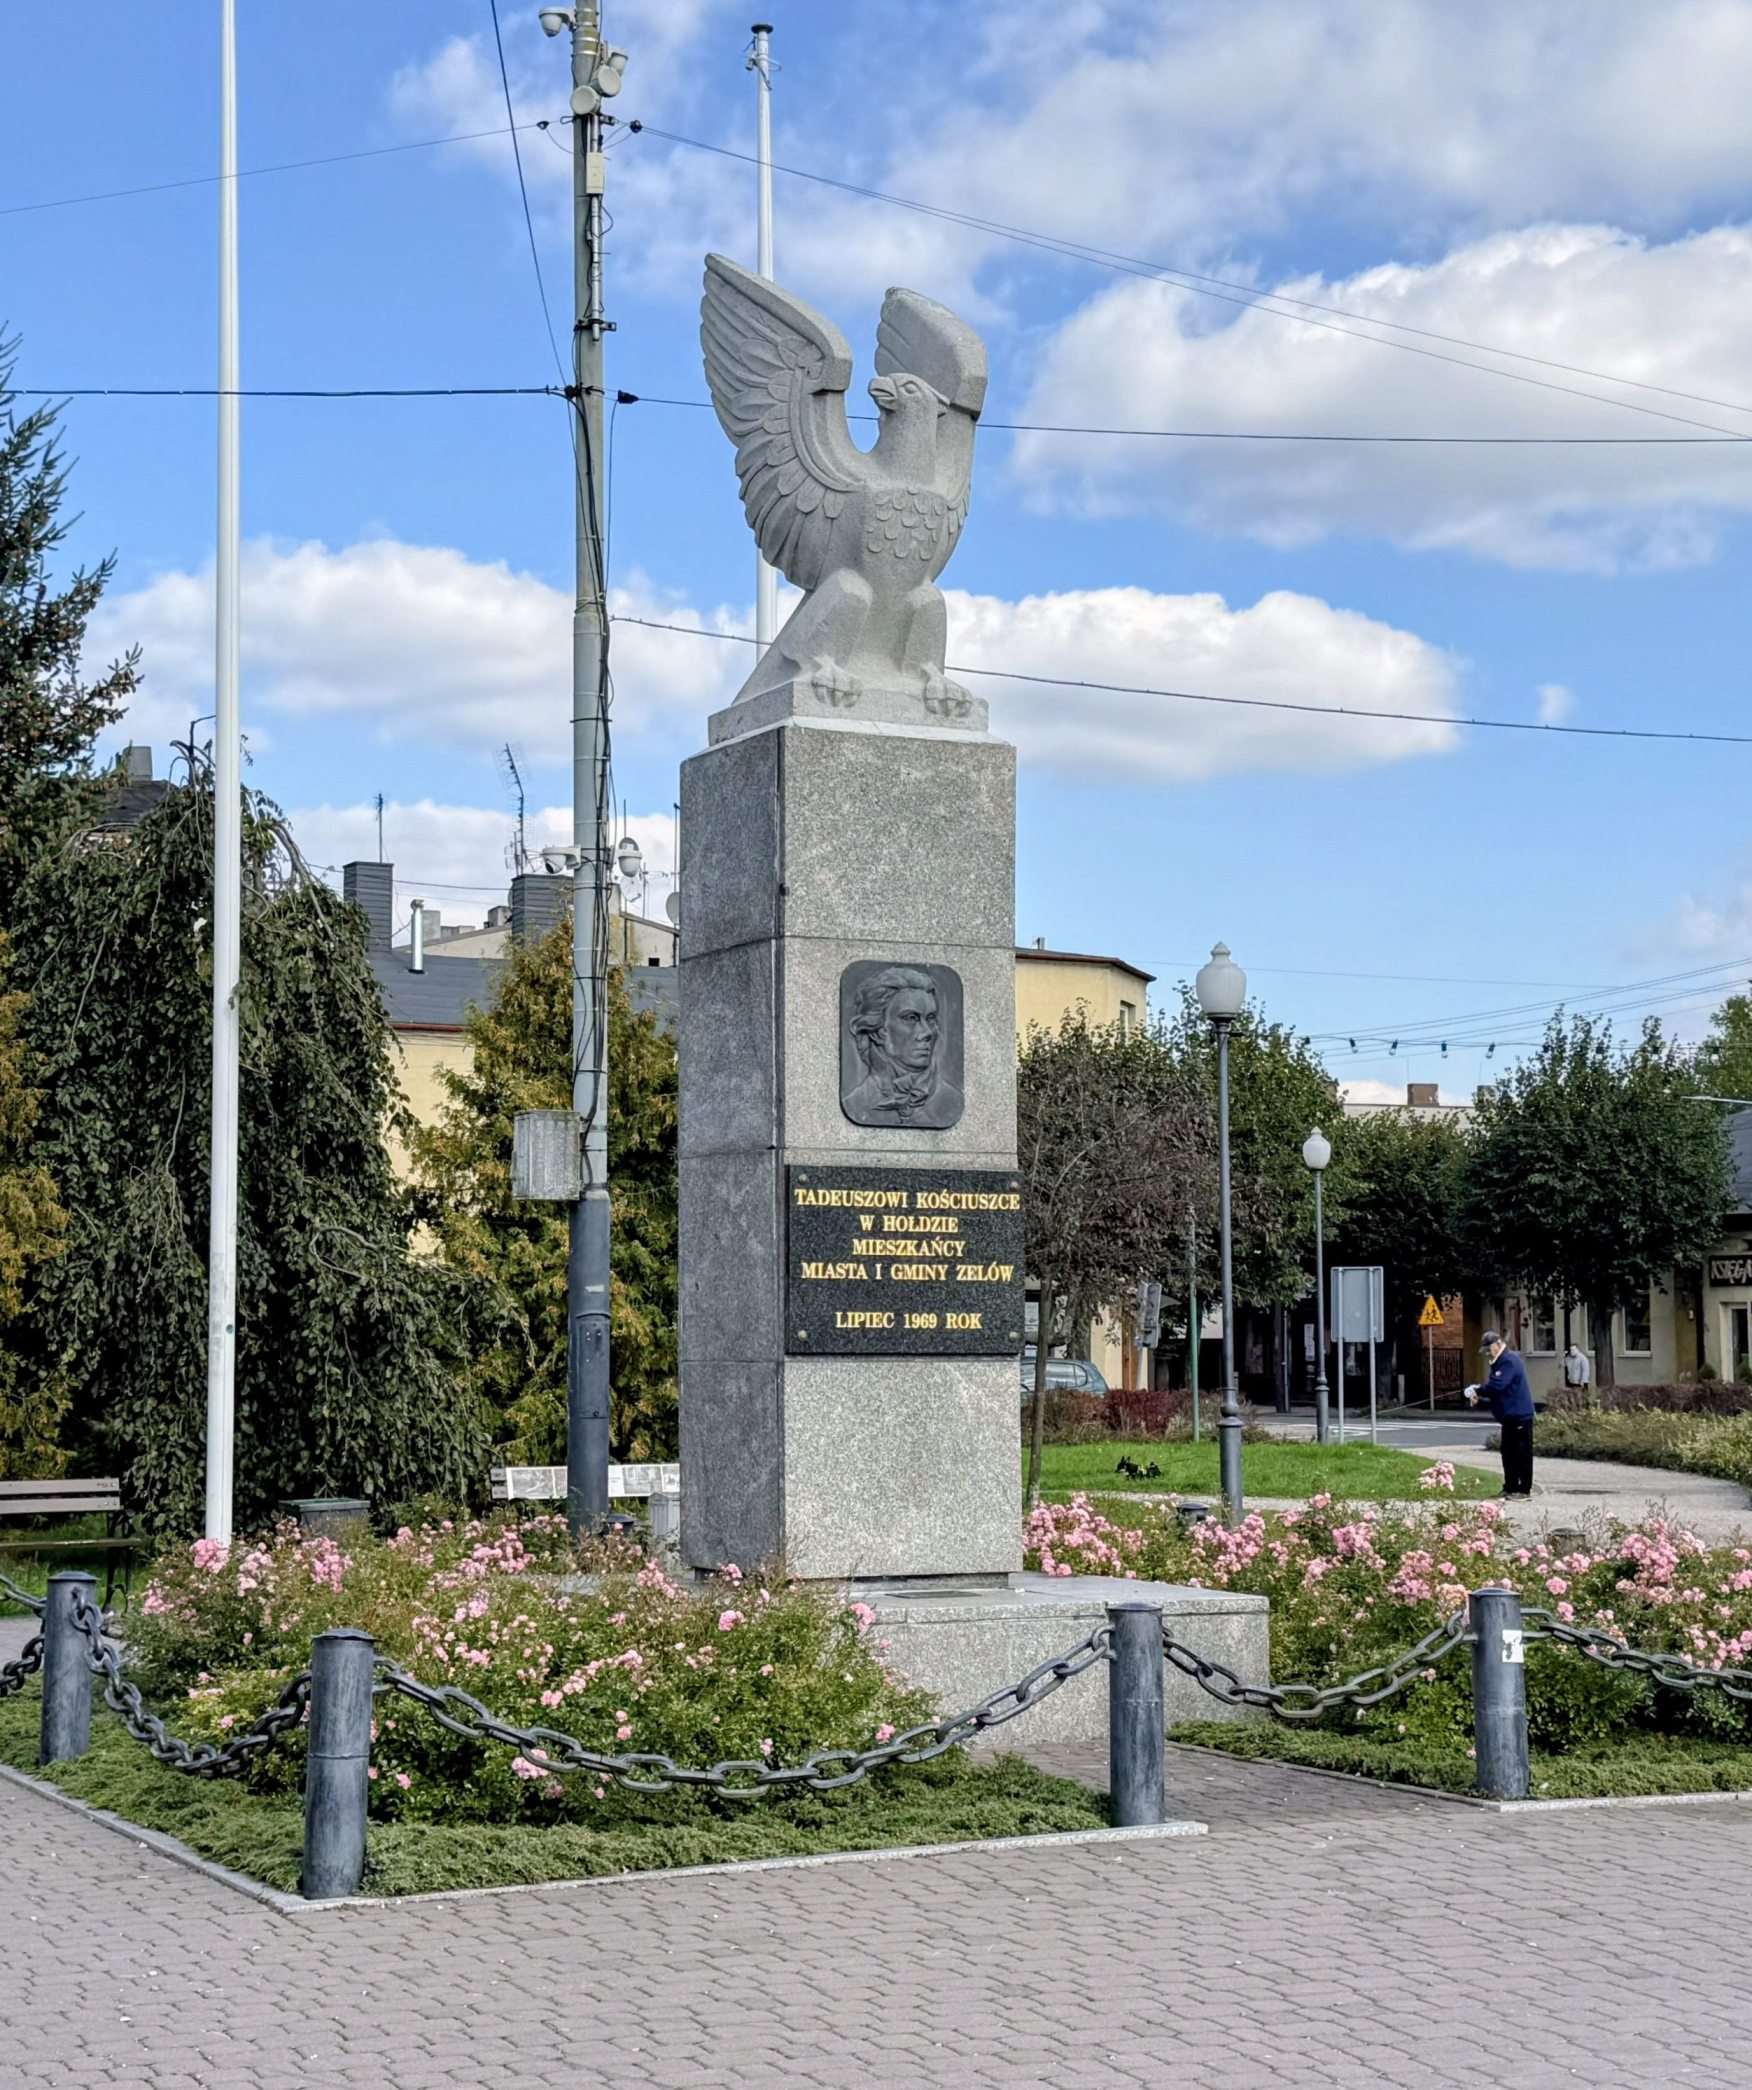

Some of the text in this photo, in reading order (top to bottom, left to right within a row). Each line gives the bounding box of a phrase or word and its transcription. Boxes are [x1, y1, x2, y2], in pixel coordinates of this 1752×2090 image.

[794, 1188, 1021, 1210] TADEUSZOWI KOŚCIUSZCE
[859, 1215, 959, 1234] W HOŁDZIE
[852, 1236, 966, 1258] MIESZKAŃCY
[801, 1261, 1015, 1282] MIASTA I GMINY ZELÓW
[836, 1312, 982, 1330] LIPIEC 1969 ROK
